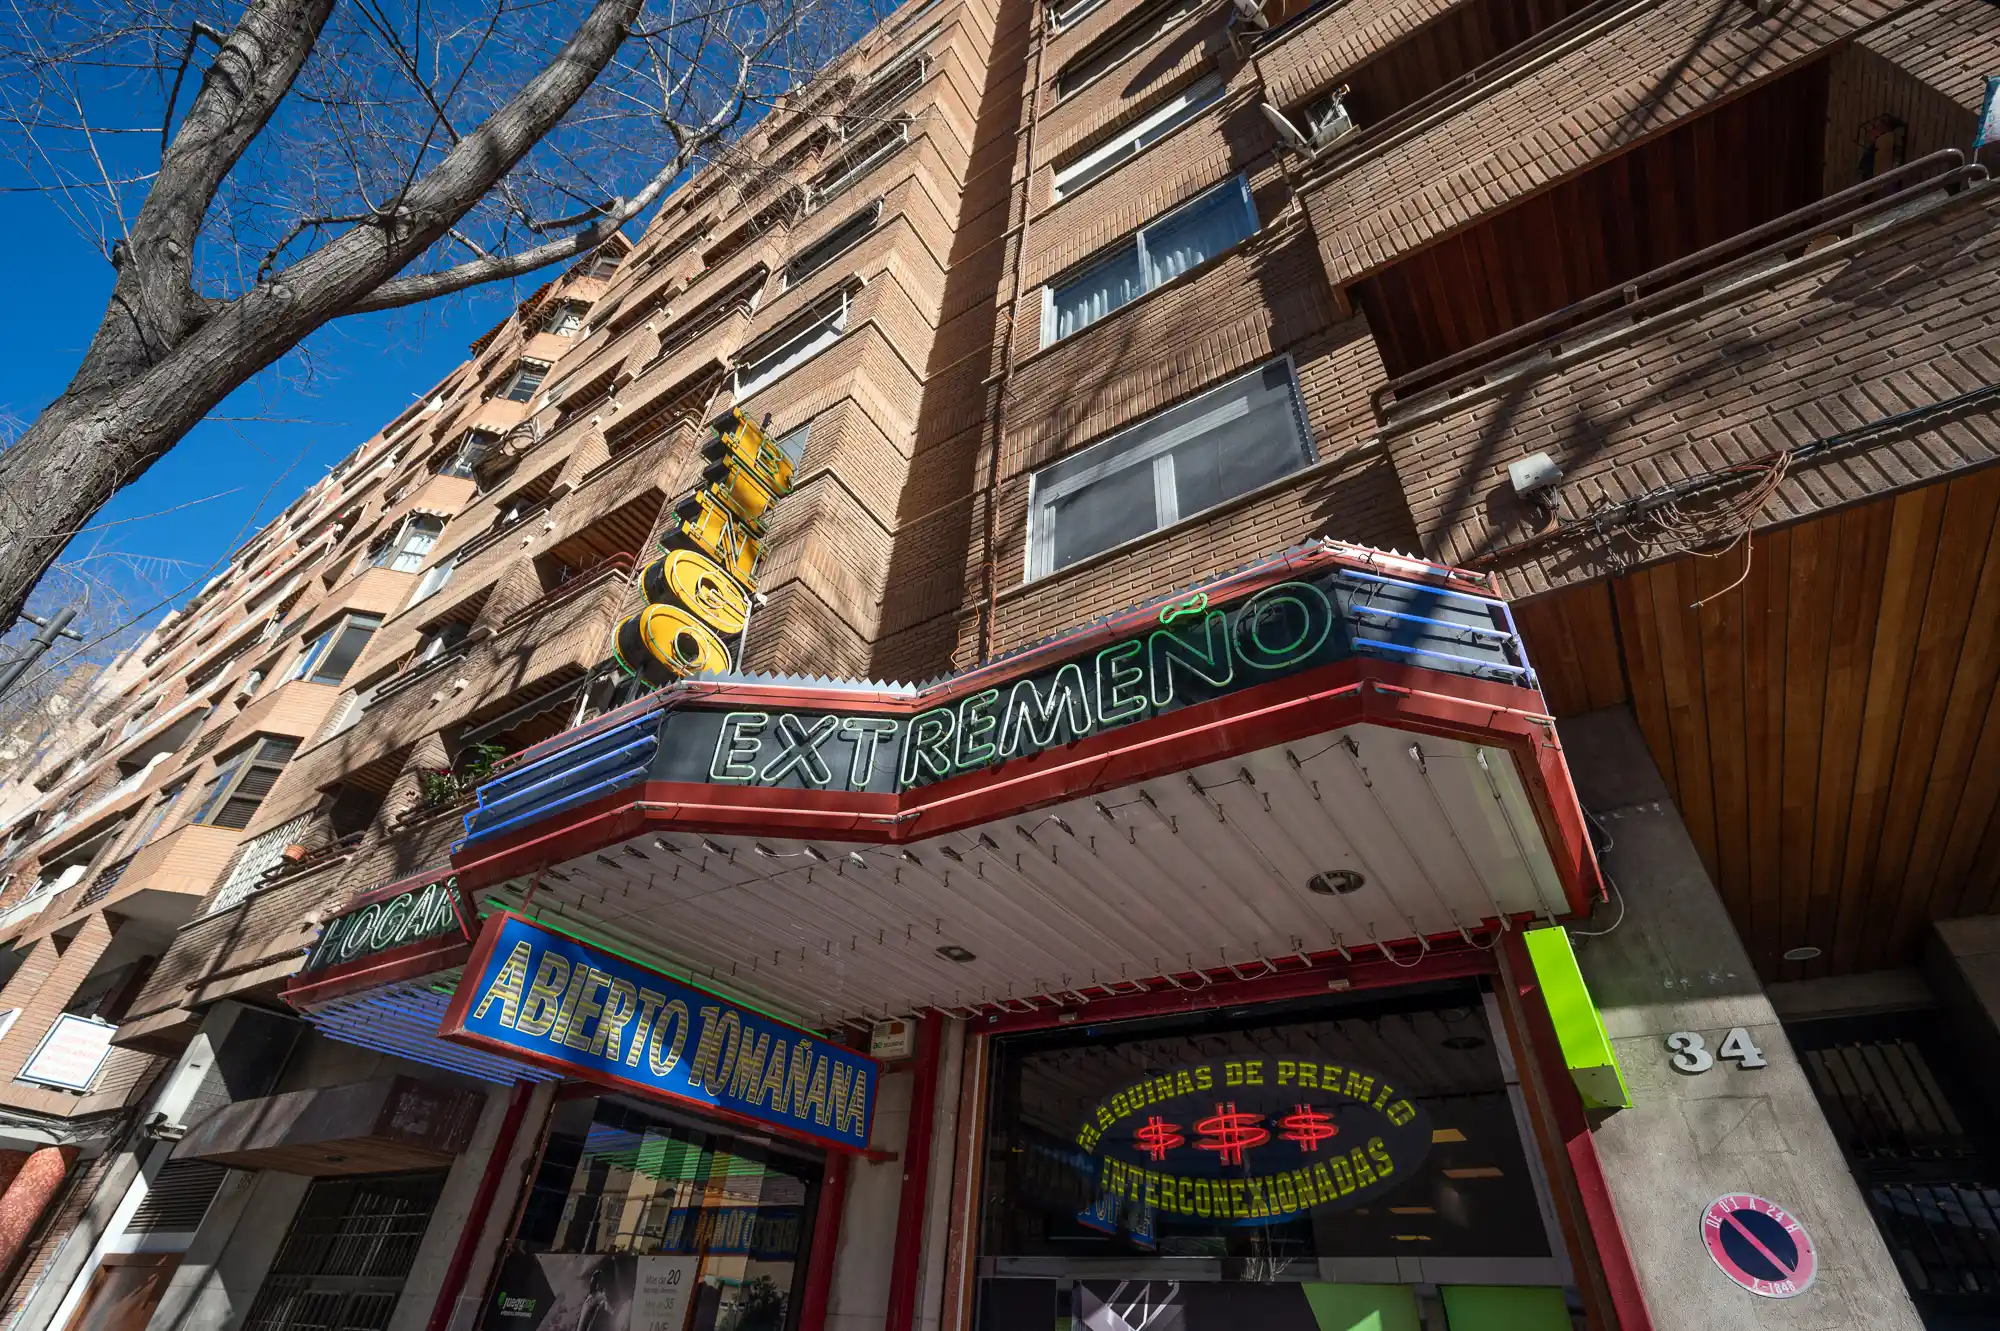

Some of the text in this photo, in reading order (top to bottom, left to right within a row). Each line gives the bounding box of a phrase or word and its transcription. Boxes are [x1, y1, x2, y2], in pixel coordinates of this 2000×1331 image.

[630, 407, 799, 680] BINGO
[709, 581, 1333, 787] EXTREMEÑO
[473, 940, 689, 1077] ABIERTO
[1667, 1028, 1768, 1072] 34
[1075, 1060, 1416, 1154] MAQUINAS DE PREMIO
[1101, 1136, 1396, 1219] INTERCONEXIONADAS
[1705, 1211, 1724, 1229] DE
[1749, 1198, 1757, 1210] A
[1766, 1204, 1785, 1222] 24
[1785, 1223, 1800, 1234] H
[667, 1268, 682, 1286] 20
